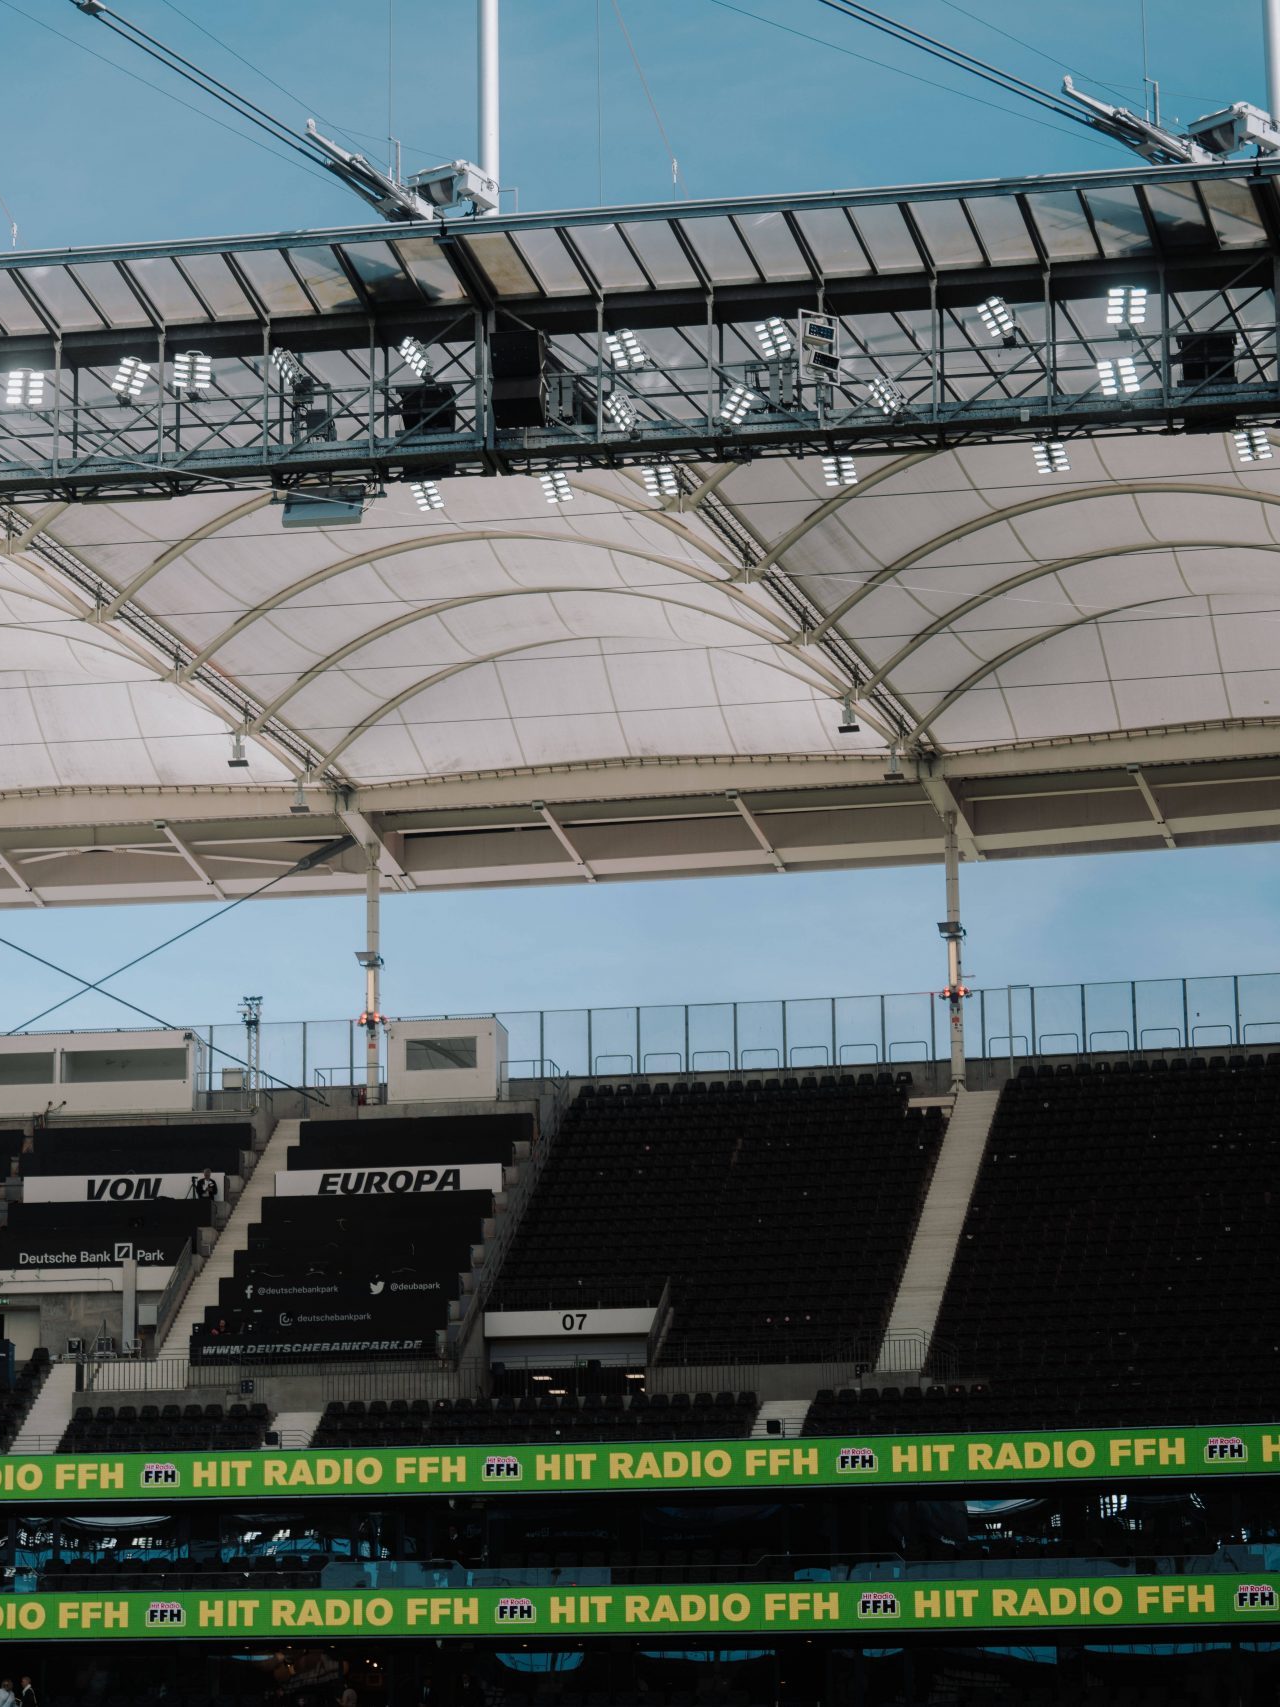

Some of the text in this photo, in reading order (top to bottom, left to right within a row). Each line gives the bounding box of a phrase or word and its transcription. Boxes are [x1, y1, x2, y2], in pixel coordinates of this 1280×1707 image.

[86, 1177, 163, 1201] VON
[318, 1168, 462, 1194] EUROPA
[19, 1249, 164, 1265] Deutsche Bank Park
[257, 1285, 339, 1297] @deutschebankpark
[390, 1281, 441, 1293] @deubapark
[297, 1312, 372, 1323] deutschebankpark
[562, 1313, 588, 1331] 07
[202, 1340, 423, 1356] WWW.DEUTSCHEBANKPARK.DE
[892, 1437, 1185, 1473] HIT RADIO FFH
[1208, 1444, 1243, 1458] FFH
[486, 1463, 518, 1477] FFH
[536, 1448, 818, 1481] HIT RADIO FFH
[840, 1455, 874, 1469] FFH
[55, 1463, 124, 1490] FFH
[144, 1470, 176, 1483] FFH
[193, 1456, 466, 1488] HIT RADIO FFH
[861, 1599, 895, 1614] FFH
[914, 1584, 1215, 1618] HIT RADIO FFH
[1238, 1591, 1274, 1607] FFH
[59, 1601, 129, 1629] FFH
[149, 1609, 181, 1622] FFH
[199, 1597, 479, 1627] HIT RADIO FFH
[499, 1605, 532, 1619] FFH
[550, 1592, 839, 1624] HIT RADIO FFH
